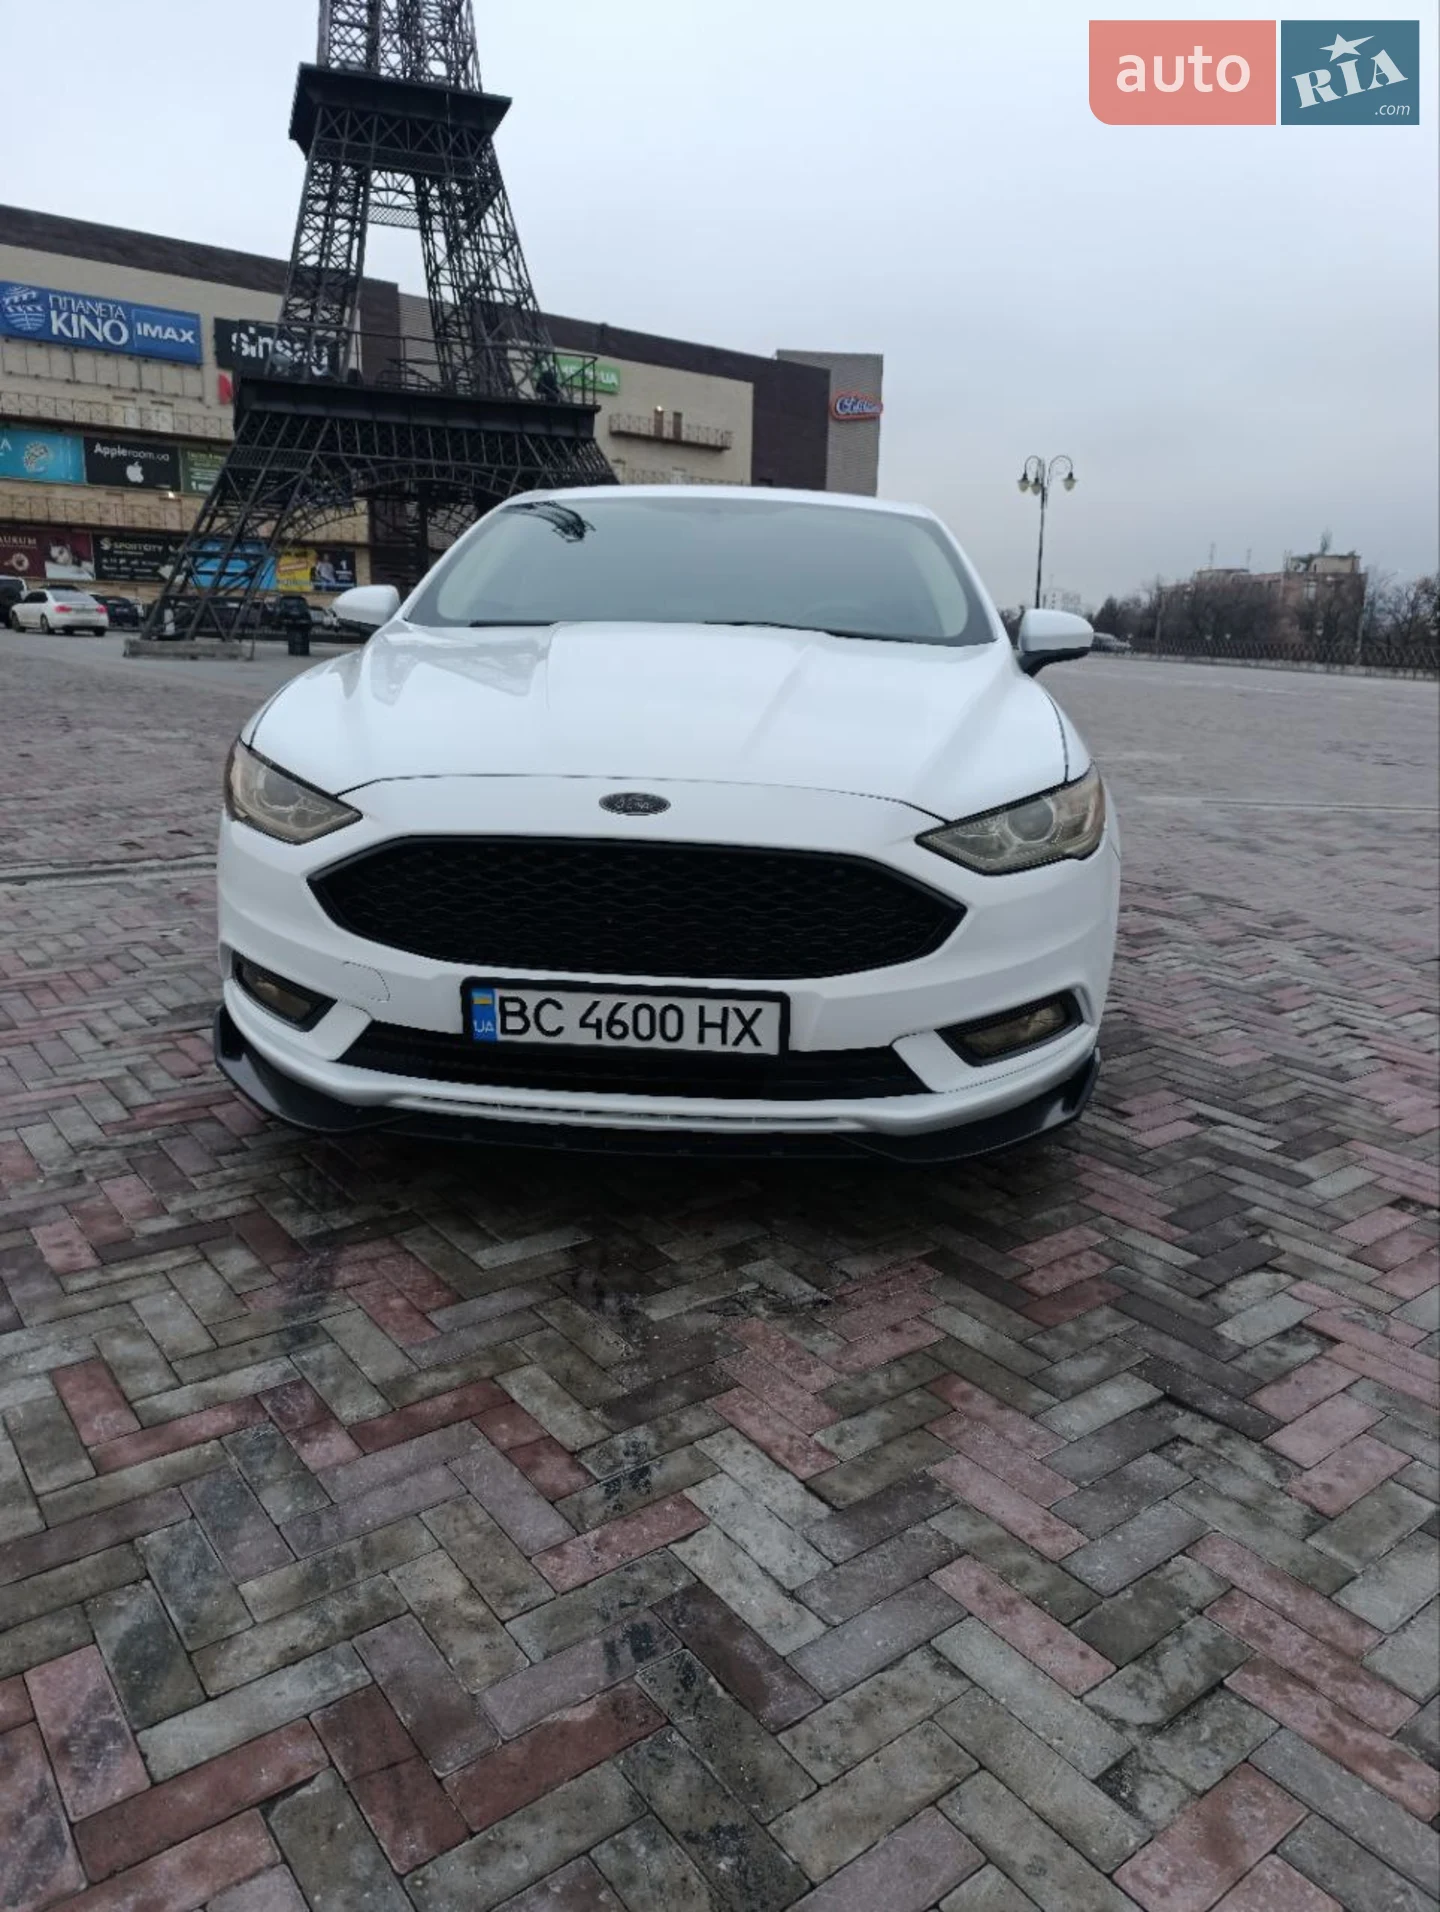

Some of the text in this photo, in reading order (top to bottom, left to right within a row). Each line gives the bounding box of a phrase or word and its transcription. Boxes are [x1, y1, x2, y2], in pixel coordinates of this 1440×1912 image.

[50, 310, 195, 345] KINO IMAX
[473, 1020, 495, 1034] UA
[498, 995, 764, 1047] BC 4600 HX
